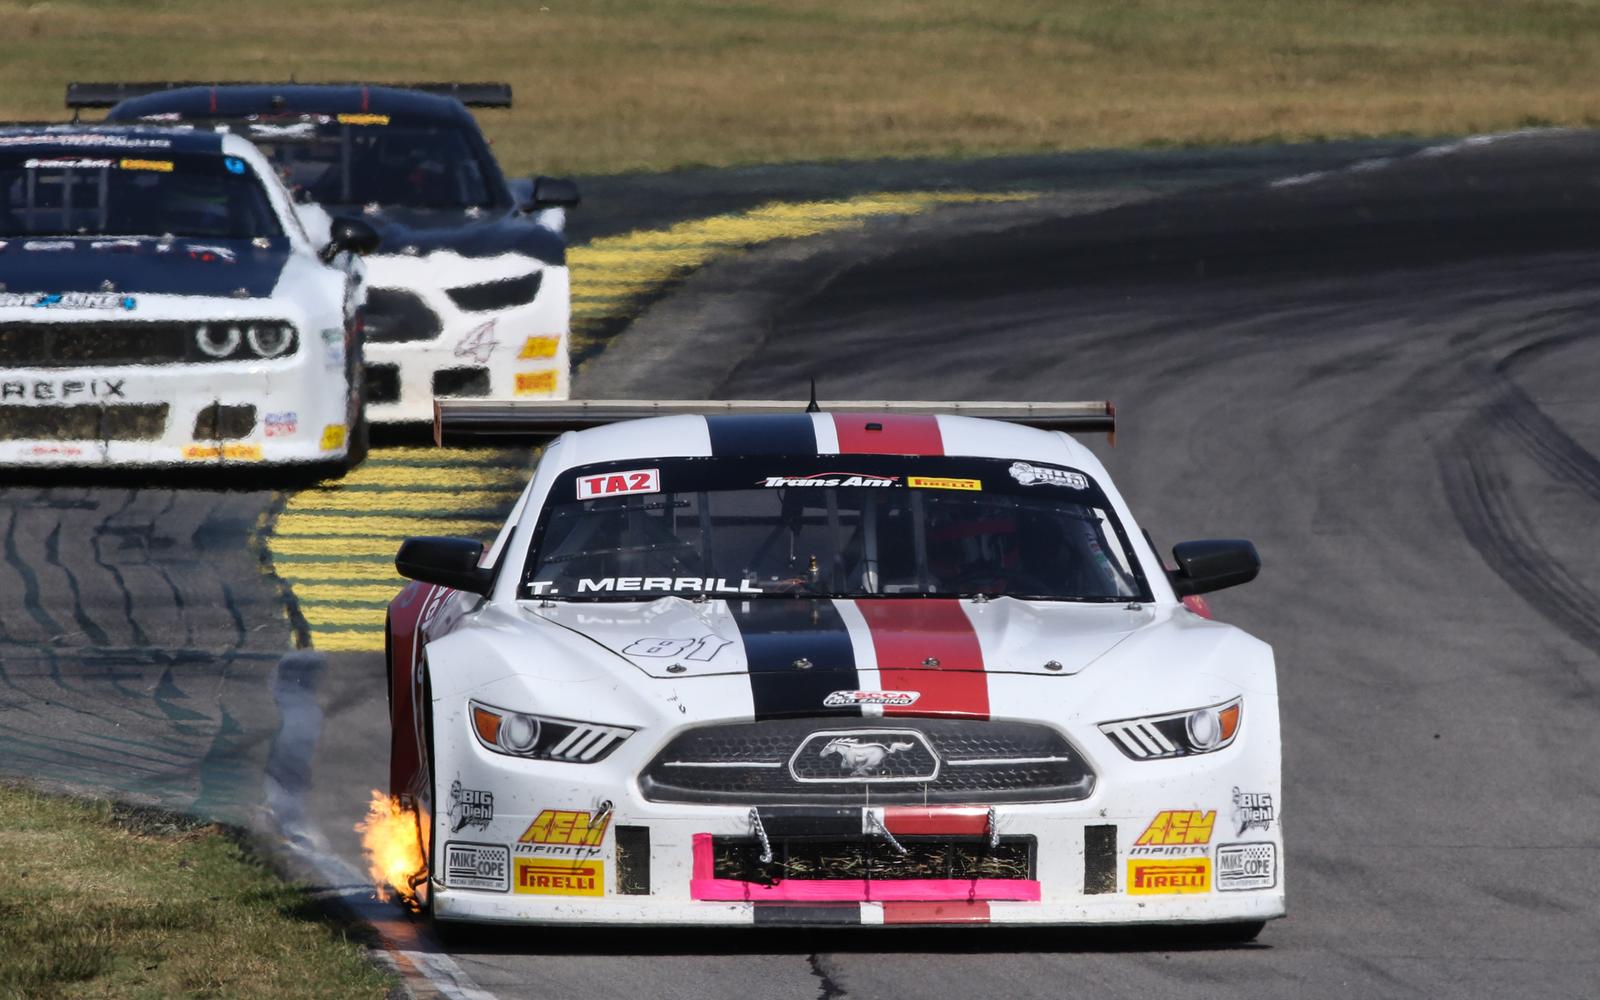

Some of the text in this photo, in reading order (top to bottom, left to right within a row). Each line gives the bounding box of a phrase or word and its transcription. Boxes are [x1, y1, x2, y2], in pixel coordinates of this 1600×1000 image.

[585, 473, 651, 495] TA2
[765, 476, 892, 487] Trans Am
[914, 479, 975, 489] PIRELLI
[527, 577, 764, 596] T. MERRILL
[622, 633, 734, 662] 81
[462, 790, 493, 804] BIG
[1240, 793, 1272, 807] BIG
[462, 804, 493, 820] Diehl
[1241, 807, 1273, 821] Diehl
[518, 809, 613, 846] AEM
[1133, 810, 1217, 846] AEM
[514, 845, 602, 856] INFINITY
[1129, 846, 1210, 855] INFINITY
[449, 852, 477, 868] MIKE
[1220, 854, 1243, 870] MIKE
[1244, 859, 1270, 875] COPE
[477, 860, 504, 877] COPE
[519, 865, 595, 890] PIRELLI
[1134, 865, 1206, 889] PIRELLI
